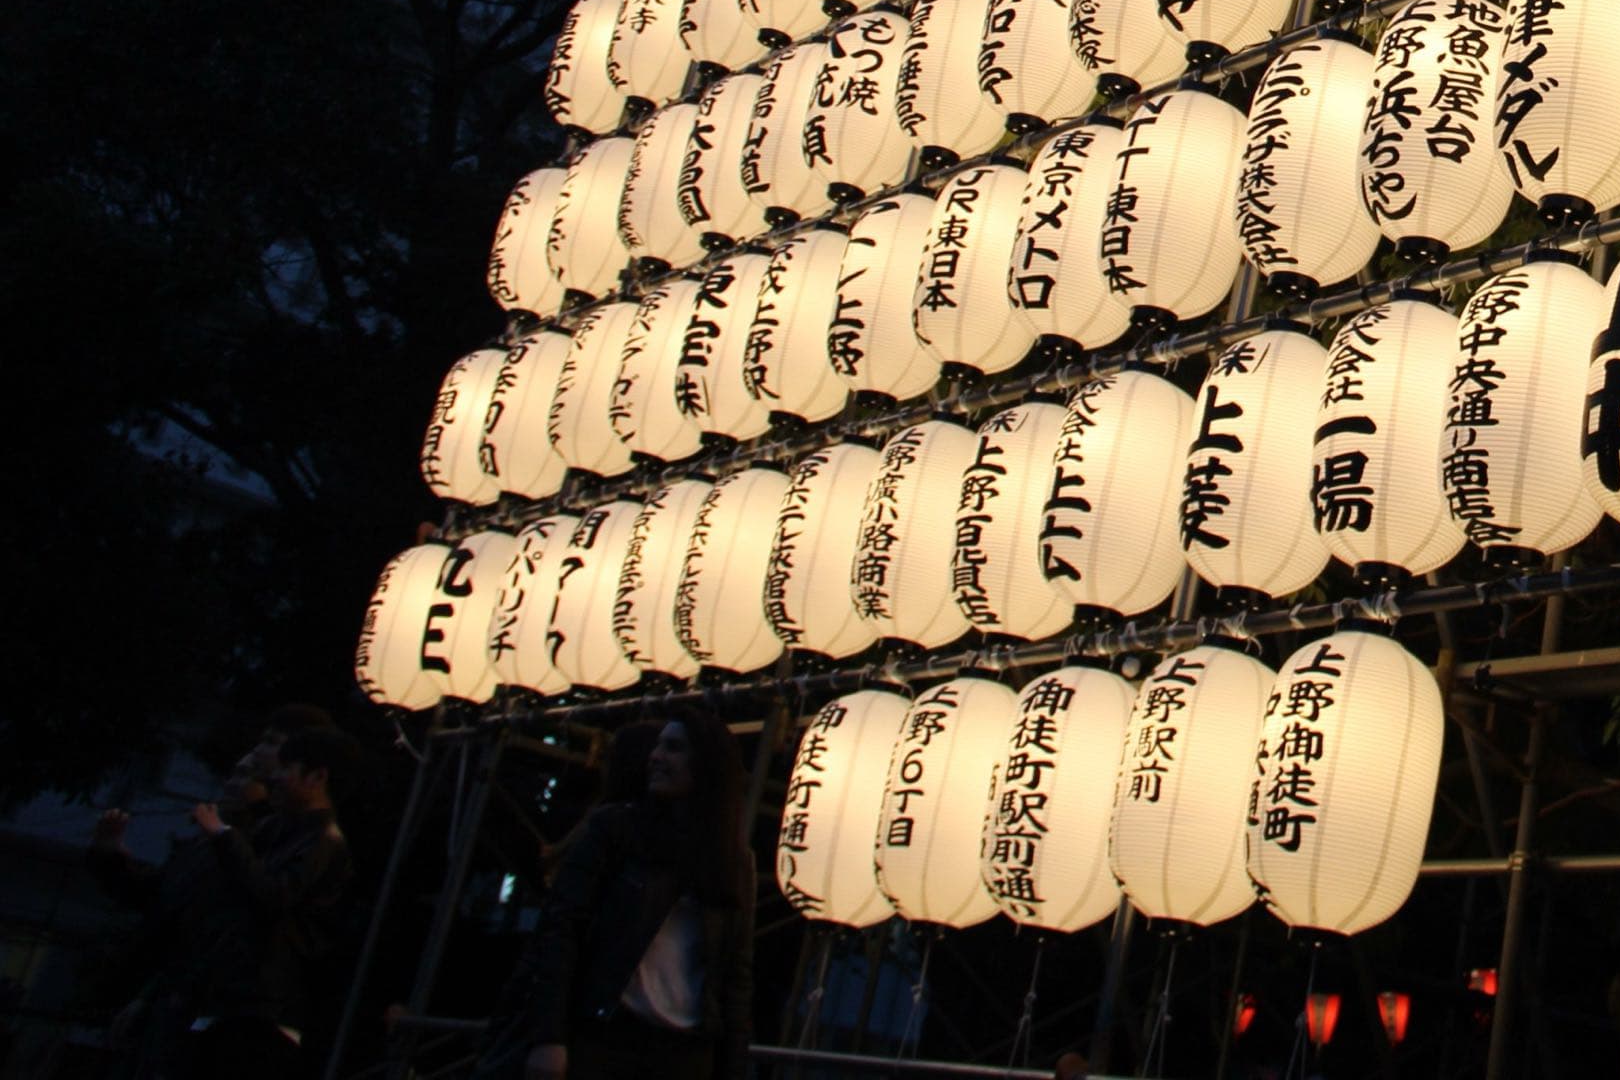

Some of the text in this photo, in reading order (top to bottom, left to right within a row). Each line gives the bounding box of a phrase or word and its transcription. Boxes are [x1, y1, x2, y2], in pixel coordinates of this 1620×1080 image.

[836, 17, 896, 116] もつ焼
[1361, 1, 1437, 226] 上野浜ちゃん
[919, 169, 995, 313] JR東日本
[1016, 130, 1096, 309] 東京メトロ
[1441, 272, 1529, 533] 上野中央通り商店会
[1127, 657, 1205, 803] 上野駅前
[1263, 643, 1345, 852] 上野御徒町
